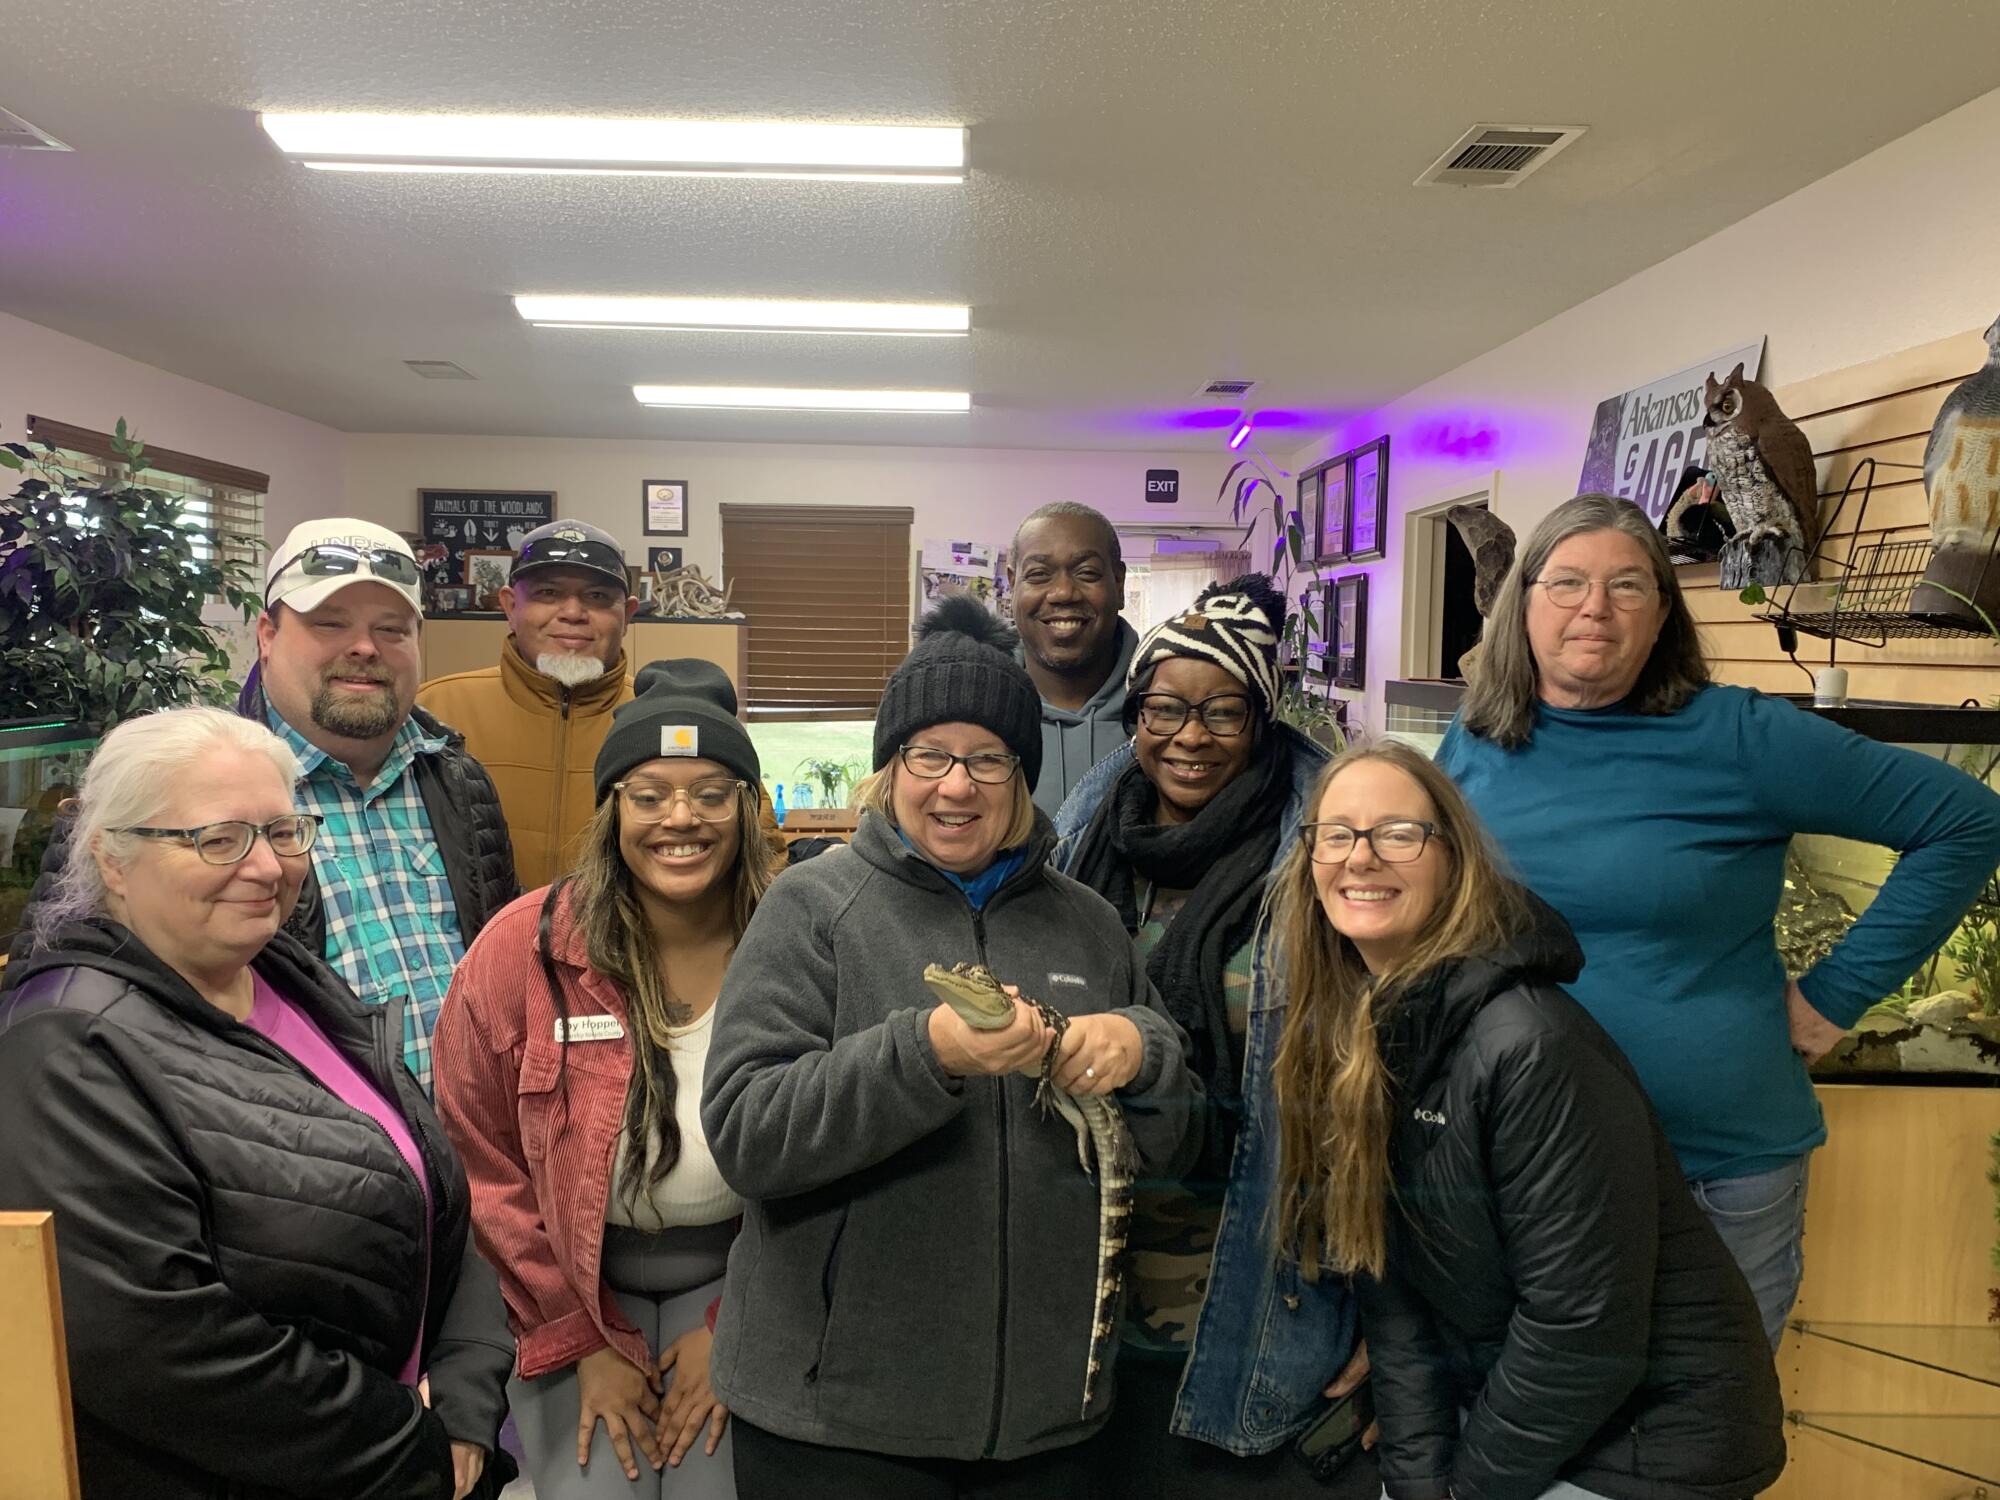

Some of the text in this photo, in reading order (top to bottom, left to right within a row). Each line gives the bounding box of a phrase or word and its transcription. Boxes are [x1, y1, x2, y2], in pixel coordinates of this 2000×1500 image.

[1622, 386, 1704, 440] Arkansas
[1148, 480, 1177, 492] EXIT
[434, 499, 544, 515] ANIMALS OF THE WOODLANDS
